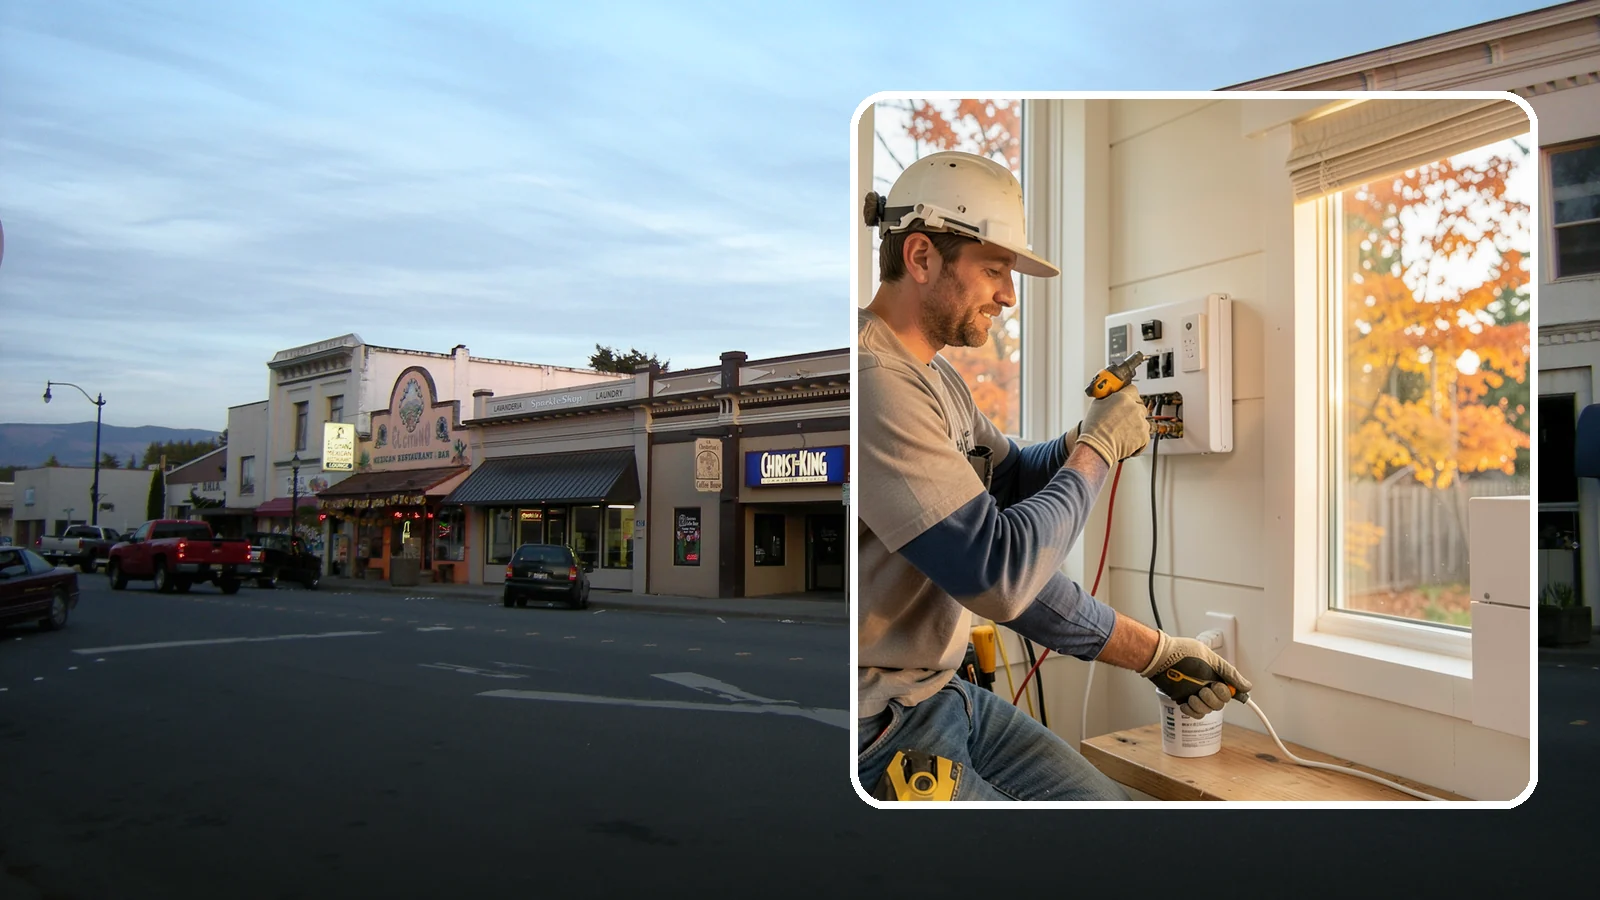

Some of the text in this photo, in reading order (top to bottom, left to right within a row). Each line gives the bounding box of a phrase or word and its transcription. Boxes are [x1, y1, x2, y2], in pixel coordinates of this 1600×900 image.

[531, 394, 582, 408] Sparkle Shop
[595, 389, 623, 399] LAUNDRY
[494, 402, 522, 412] LAVANDERIA
[374, 455, 396, 464] MEXICAN
[397, 452, 433, 462] RESTAURANT
[438, 450, 450, 459] BAR
[761, 450, 827, 478] CHRIST KING
